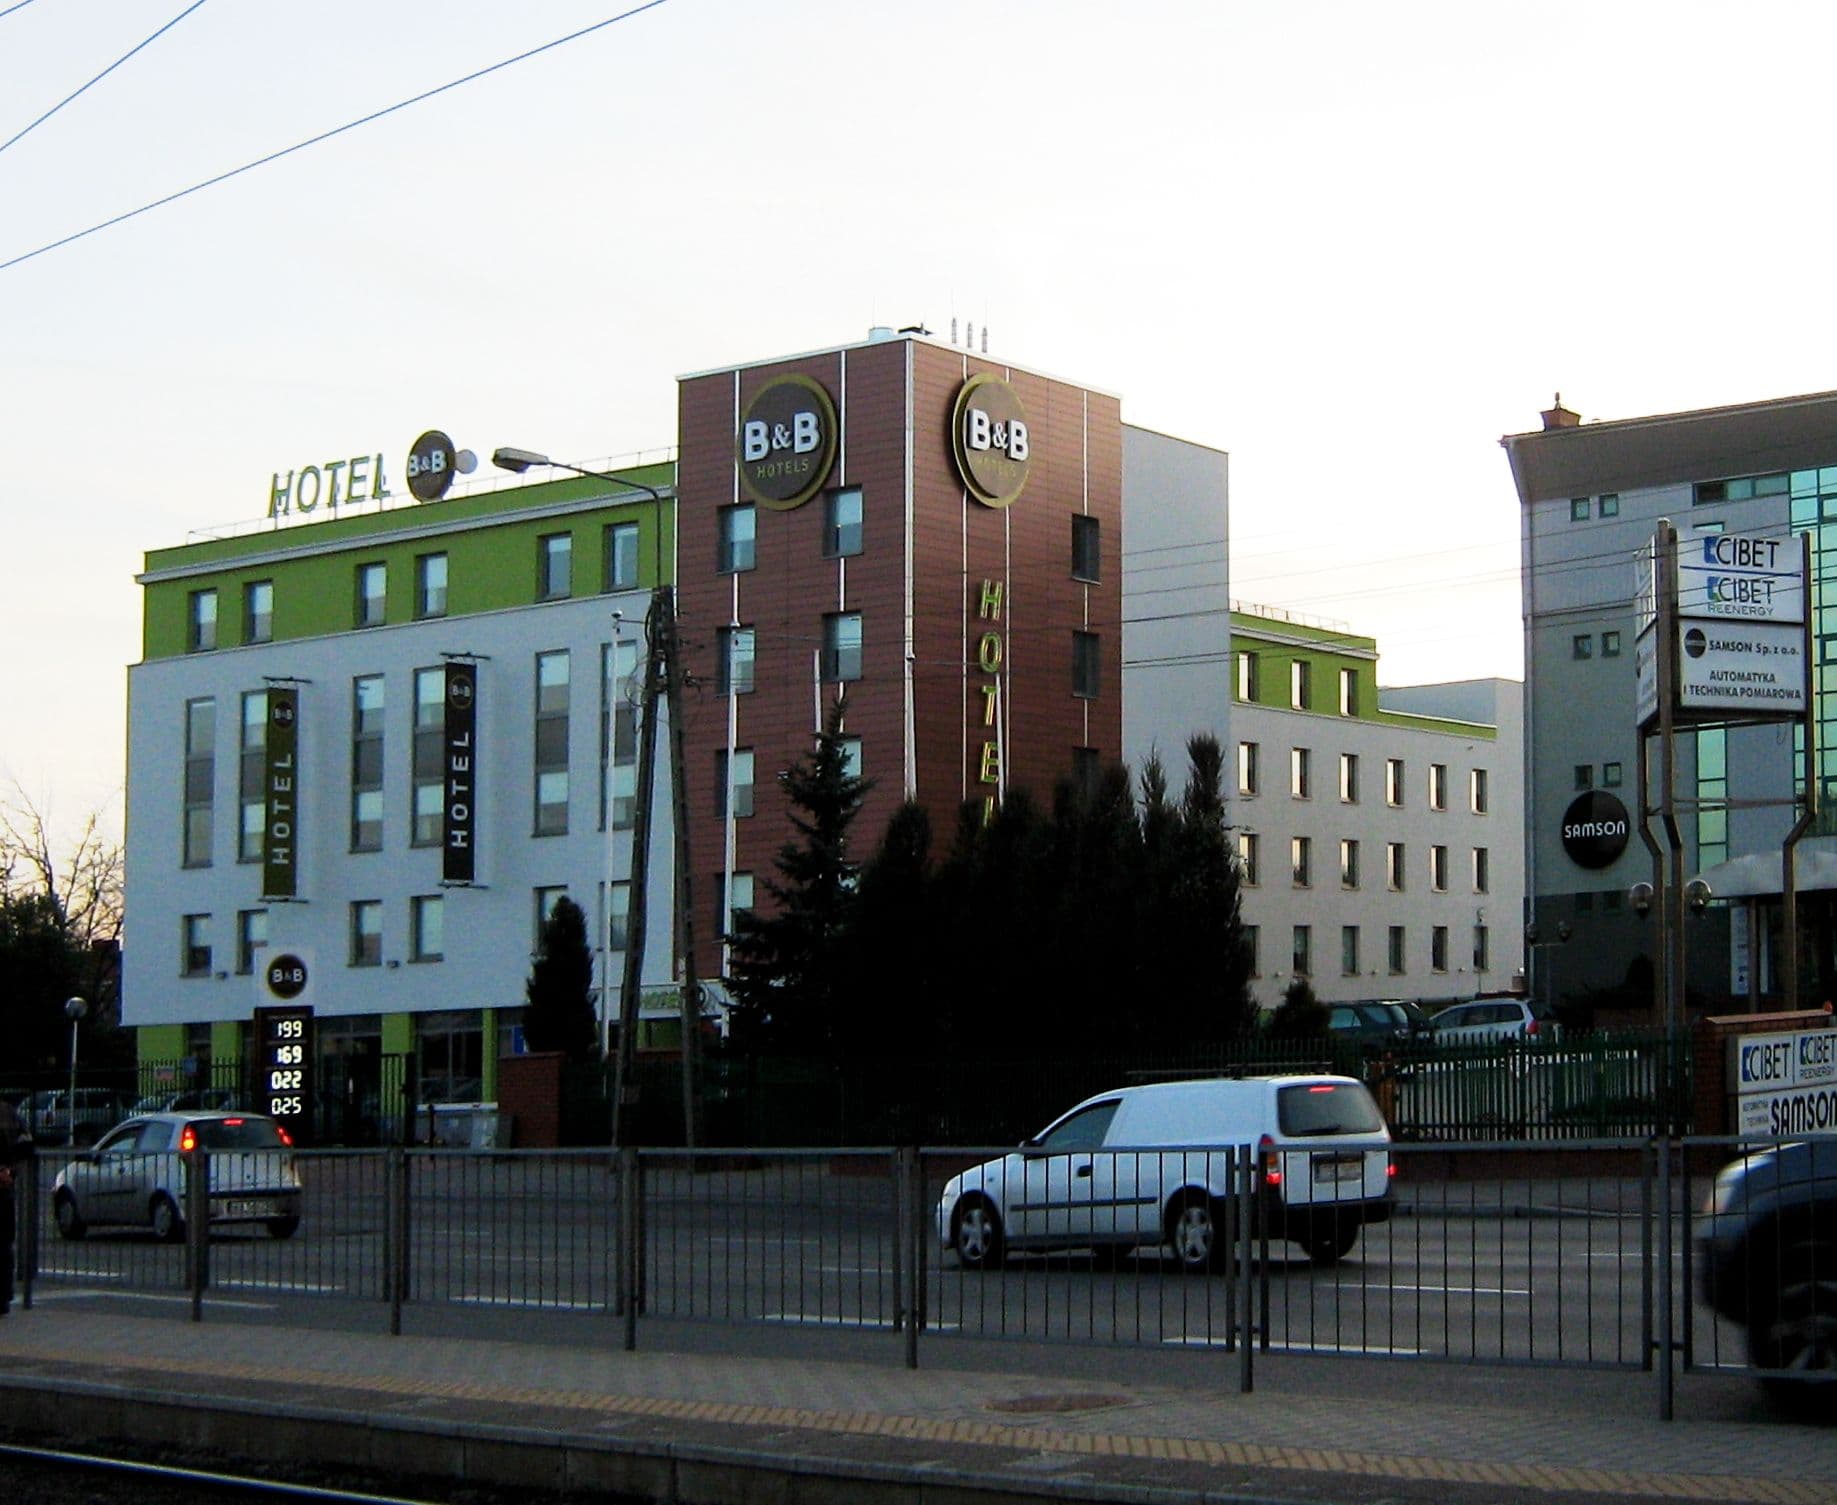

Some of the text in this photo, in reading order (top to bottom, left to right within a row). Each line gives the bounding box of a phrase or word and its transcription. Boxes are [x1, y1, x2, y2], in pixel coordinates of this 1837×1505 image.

[744, 411, 820, 462] B&B
[966, 408, 1029, 462] B&B
[407, 450, 447, 478] B&B
[756, 458, 810, 479] HOTELS
[268, 452, 391, 518] HOTEL
[1716, 537, 1780, 569] CIBET
[1718, 577, 1775, 605] CIBET
[1707, 602, 1774, 617] REENERGY
[1709, 639, 1800, 656] SAMSON Sp. z o.o.
[1709, 670, 1776, 684] AUTOMATYKA
[1689, 684, 1739, 697] TECHNIKA
[1740, 687, 1802, 700] POMIAROWA
[451, 731, 470, 848] HOTEL
[272, 752, 292, 866] HOTEL
[272, 967, 304, 983] B&B
[277, 1020, 303, 1039] 199
[276, 1045, 303, 1065] 169
[1749, 1042, 1791, 1081] CIBET
[271, 1070, 303, 1090] 022
[271, 1096, 302, 1115] 025
